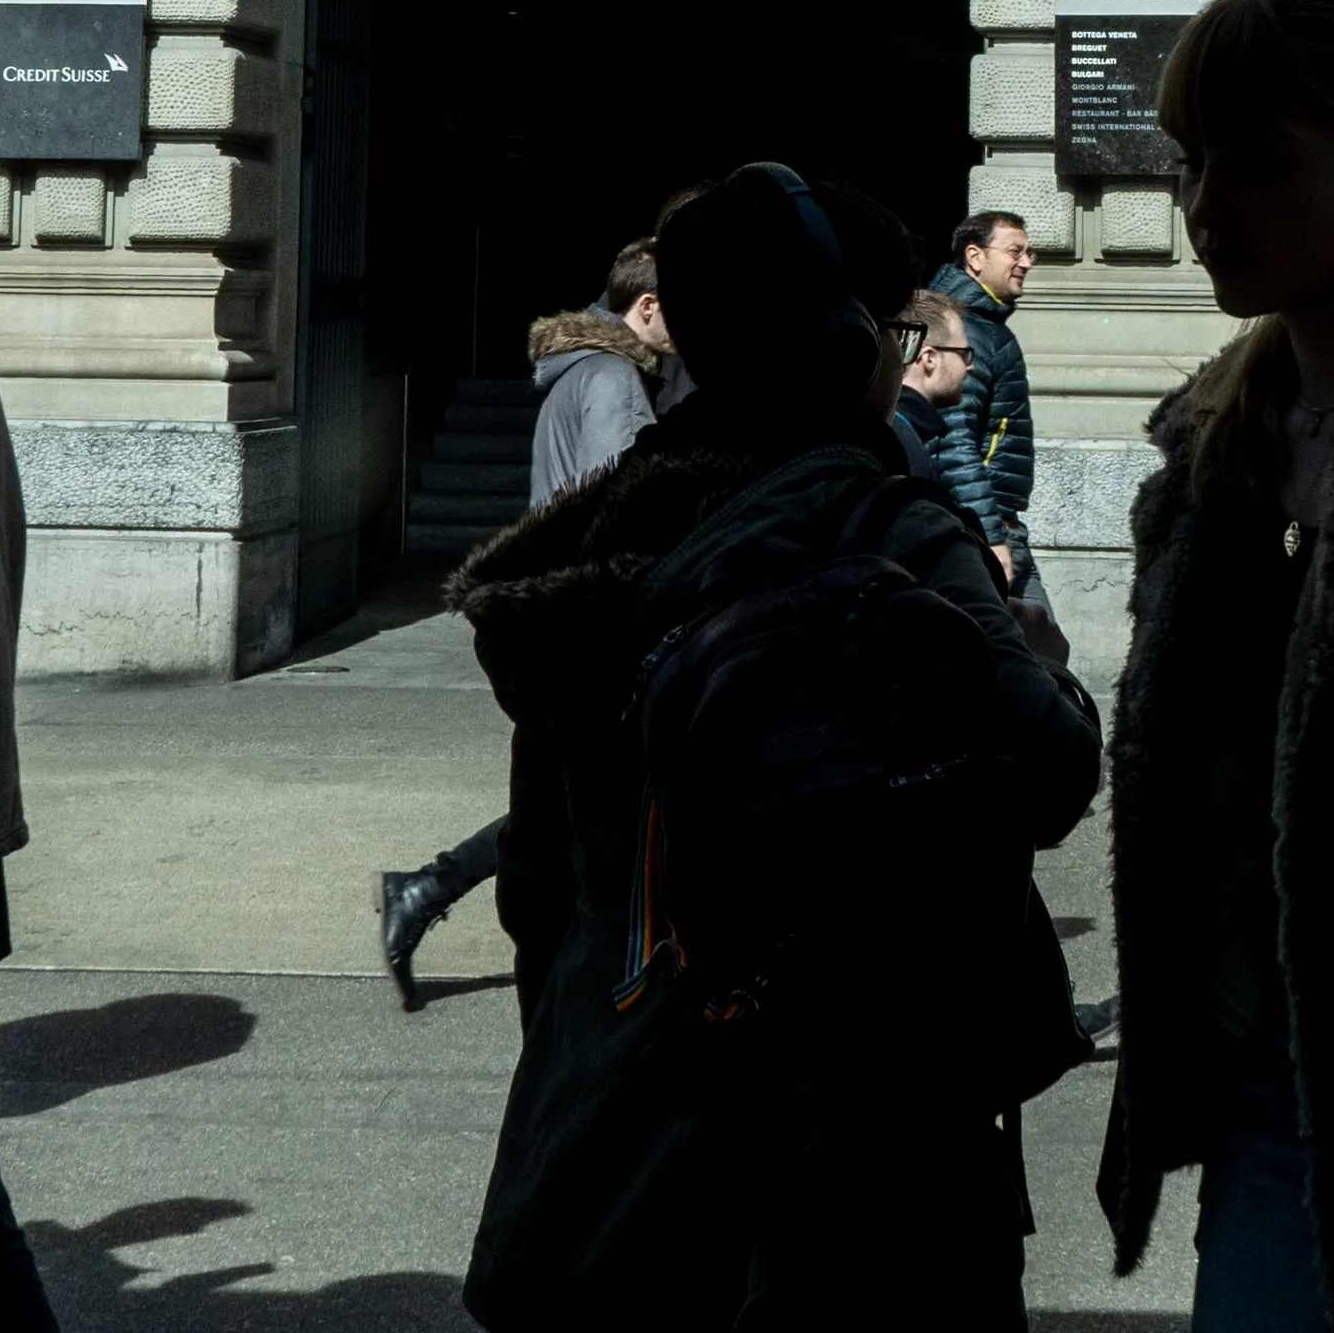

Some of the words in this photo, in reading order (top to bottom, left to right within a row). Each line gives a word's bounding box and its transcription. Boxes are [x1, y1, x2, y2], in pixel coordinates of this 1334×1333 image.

[1071, 31, 1107, 39] BOTTEGA
[1108, 31, 1138, 39] VENETA
[1071, 44, 1107, 52] BREGUET
[1071, 57, 1117, 65] BUCCELLATI
[2, 66, 60, 83] CREDIT
[61, 66, 111, 83] SUISSE
[1072, 83, 1104, 91] GIORGIO
[1106, 83, 1135, 91] ARMANI
[1071, 96, 1118, 104] MONTBLANC
[1071, 109, 1120, 117] RESTAURANT
[1126, 109, 1142, 117] BAR
[1071, 123, 1096, 131] SWISS
[1097, 123, 1156, 131] INTERNATIONAL
[1071, 136, 1098, 144] ZEGNA
